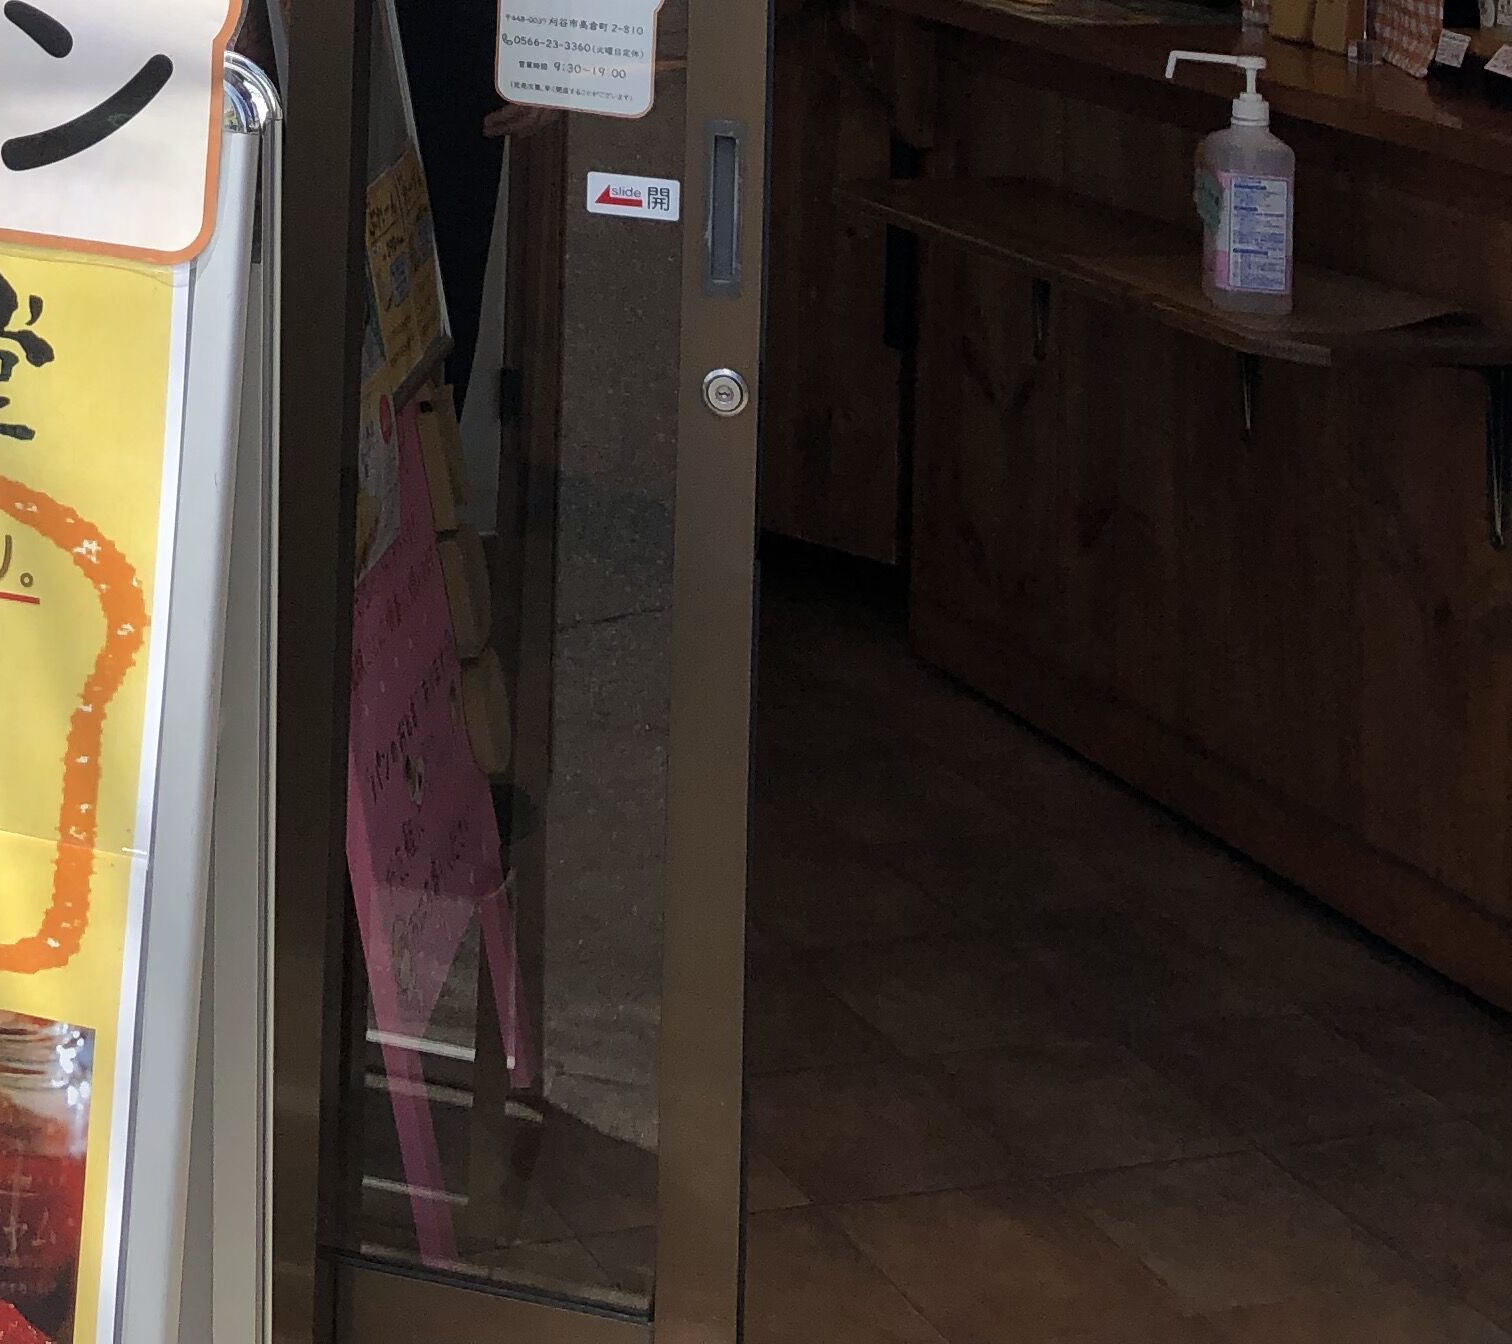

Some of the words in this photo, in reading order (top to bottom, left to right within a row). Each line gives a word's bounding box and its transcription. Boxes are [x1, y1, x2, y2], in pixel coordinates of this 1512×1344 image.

[611, 22, 644, 36] 2-810
[611, 186, 642, 198] slide
[648, 186, 670, 212] 開
